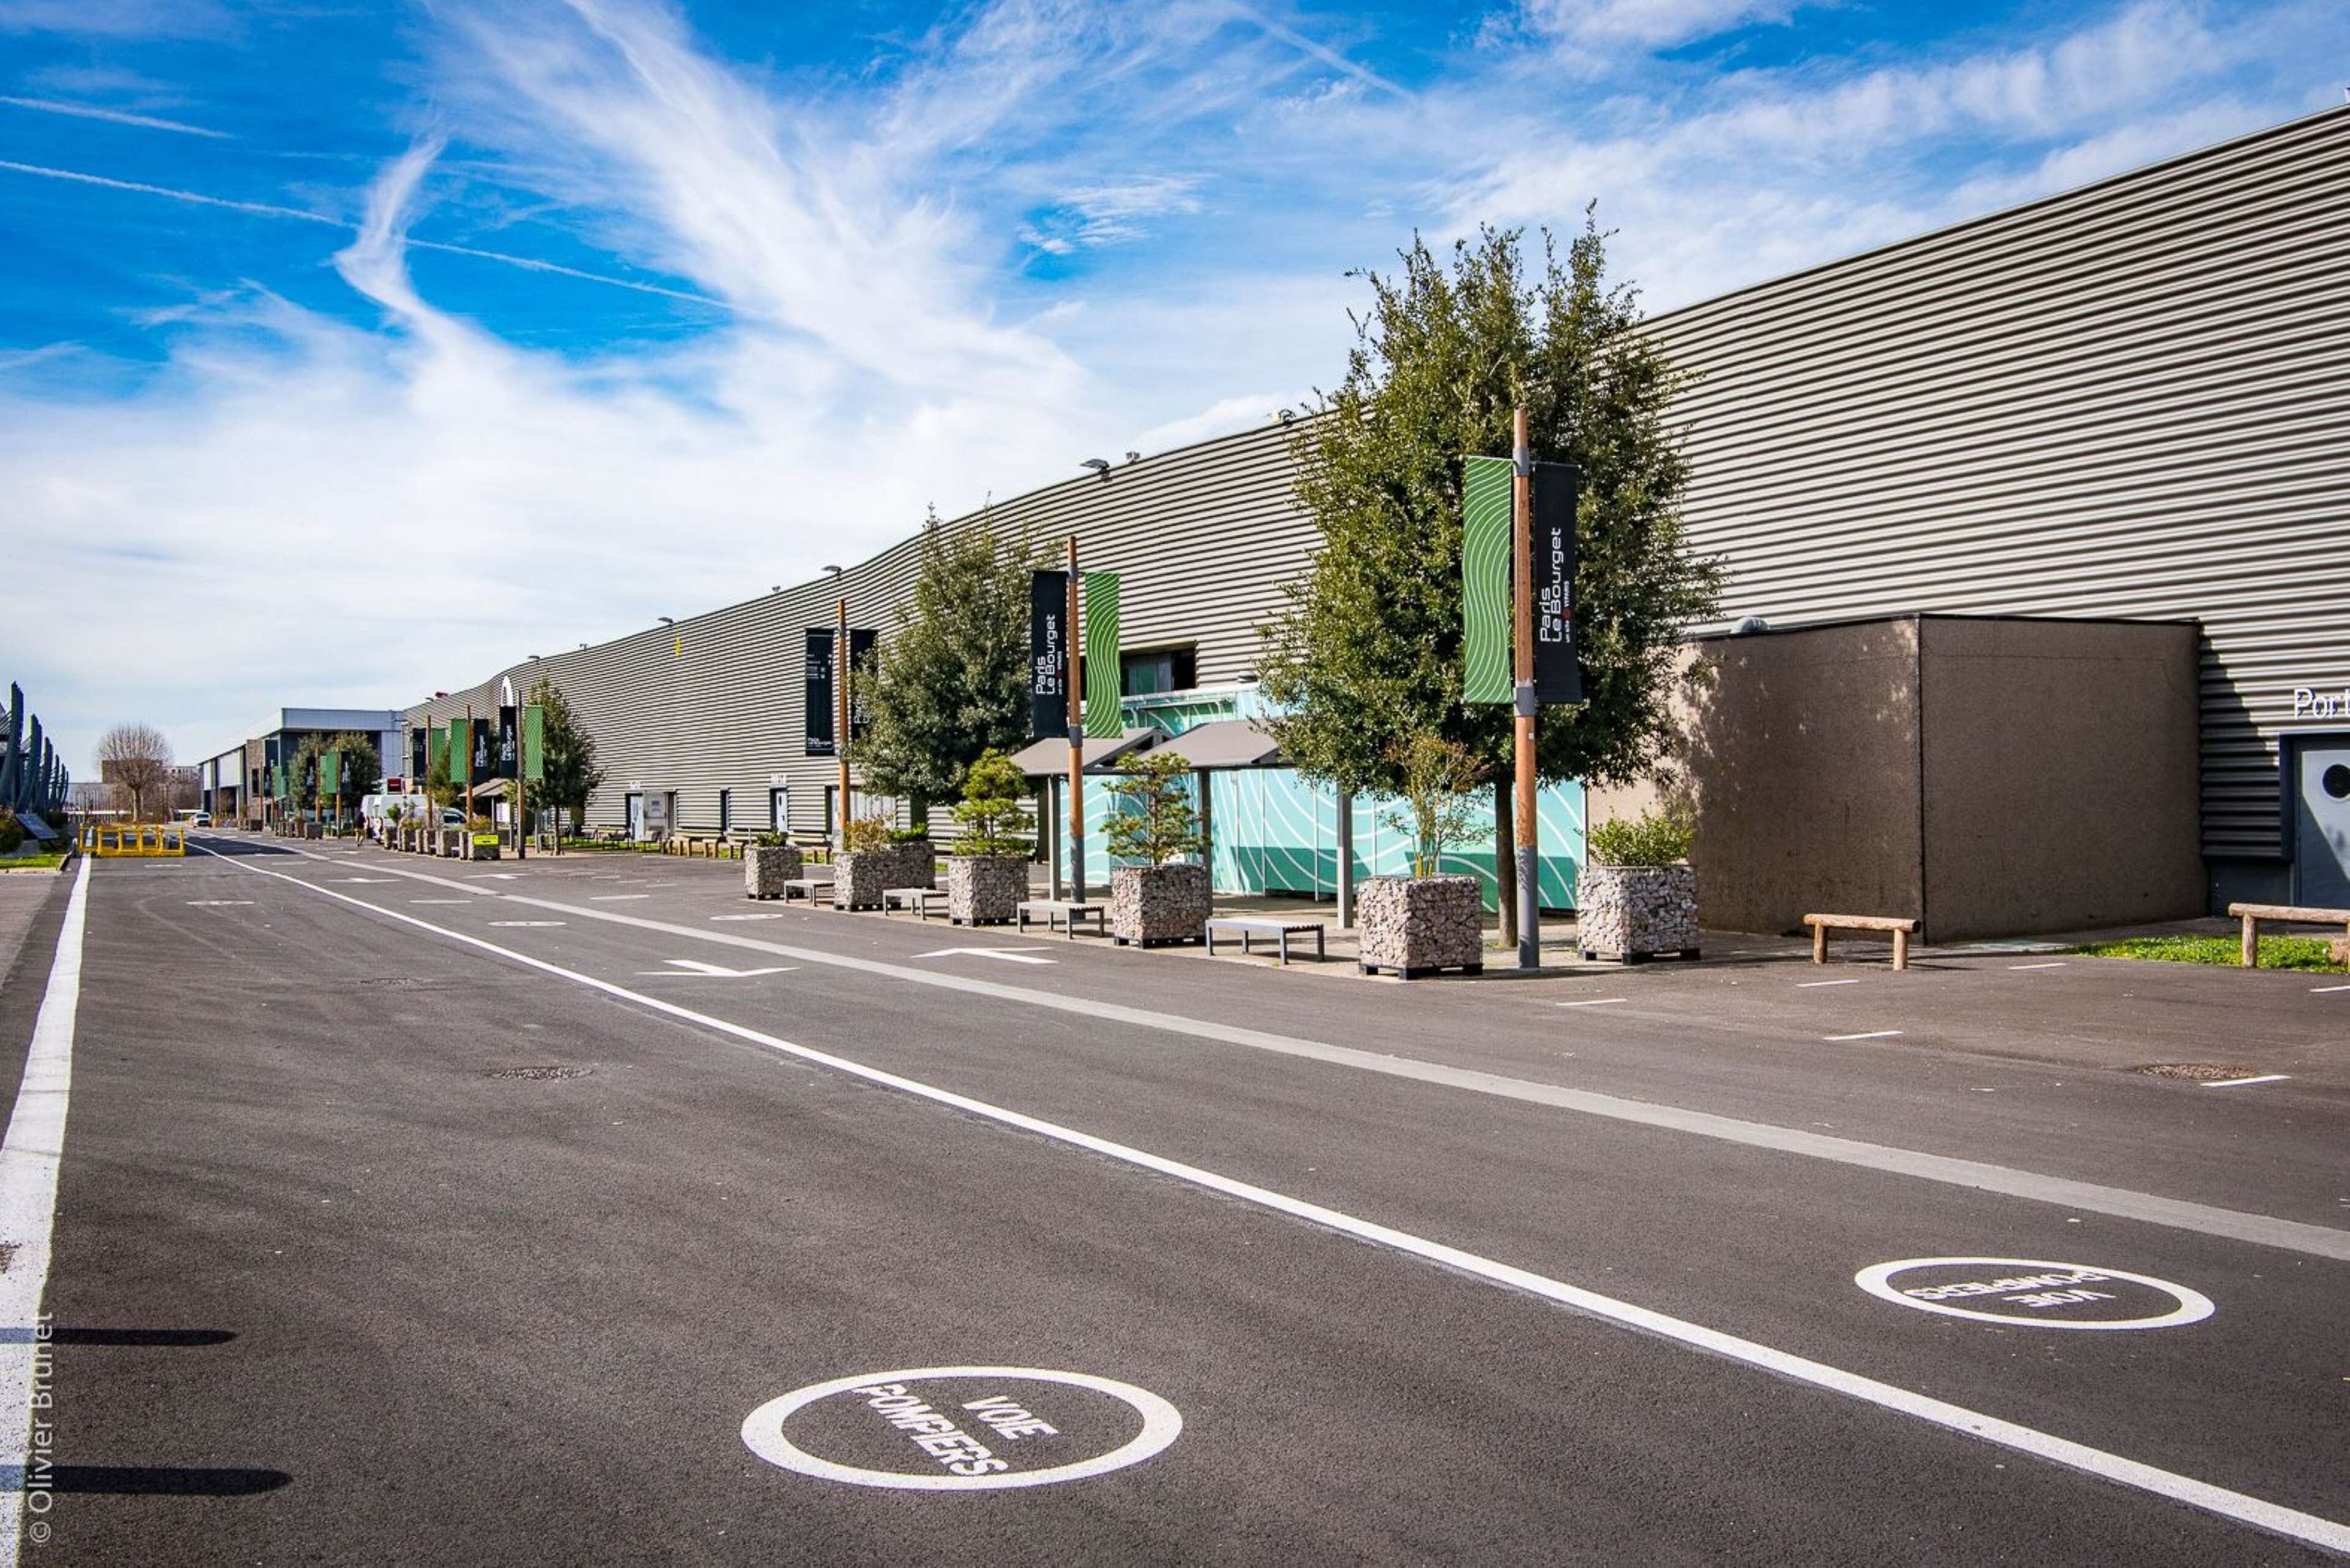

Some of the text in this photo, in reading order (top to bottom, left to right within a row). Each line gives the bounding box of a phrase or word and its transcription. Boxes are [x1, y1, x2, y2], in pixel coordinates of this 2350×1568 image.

[1551, 527, 1564, 642] Le Bourget
[1539, 587, 1551, 641] Paris
[1035, 655, 1046, 695] Paris
[1045, 614, 1058, 695] Le Bourget
[2002, 1290, 2117, 1307] VOIE
[851, 1384, 1009, 1476] POMPIERS
[962, 1395, 1060, 1439] VOIE
